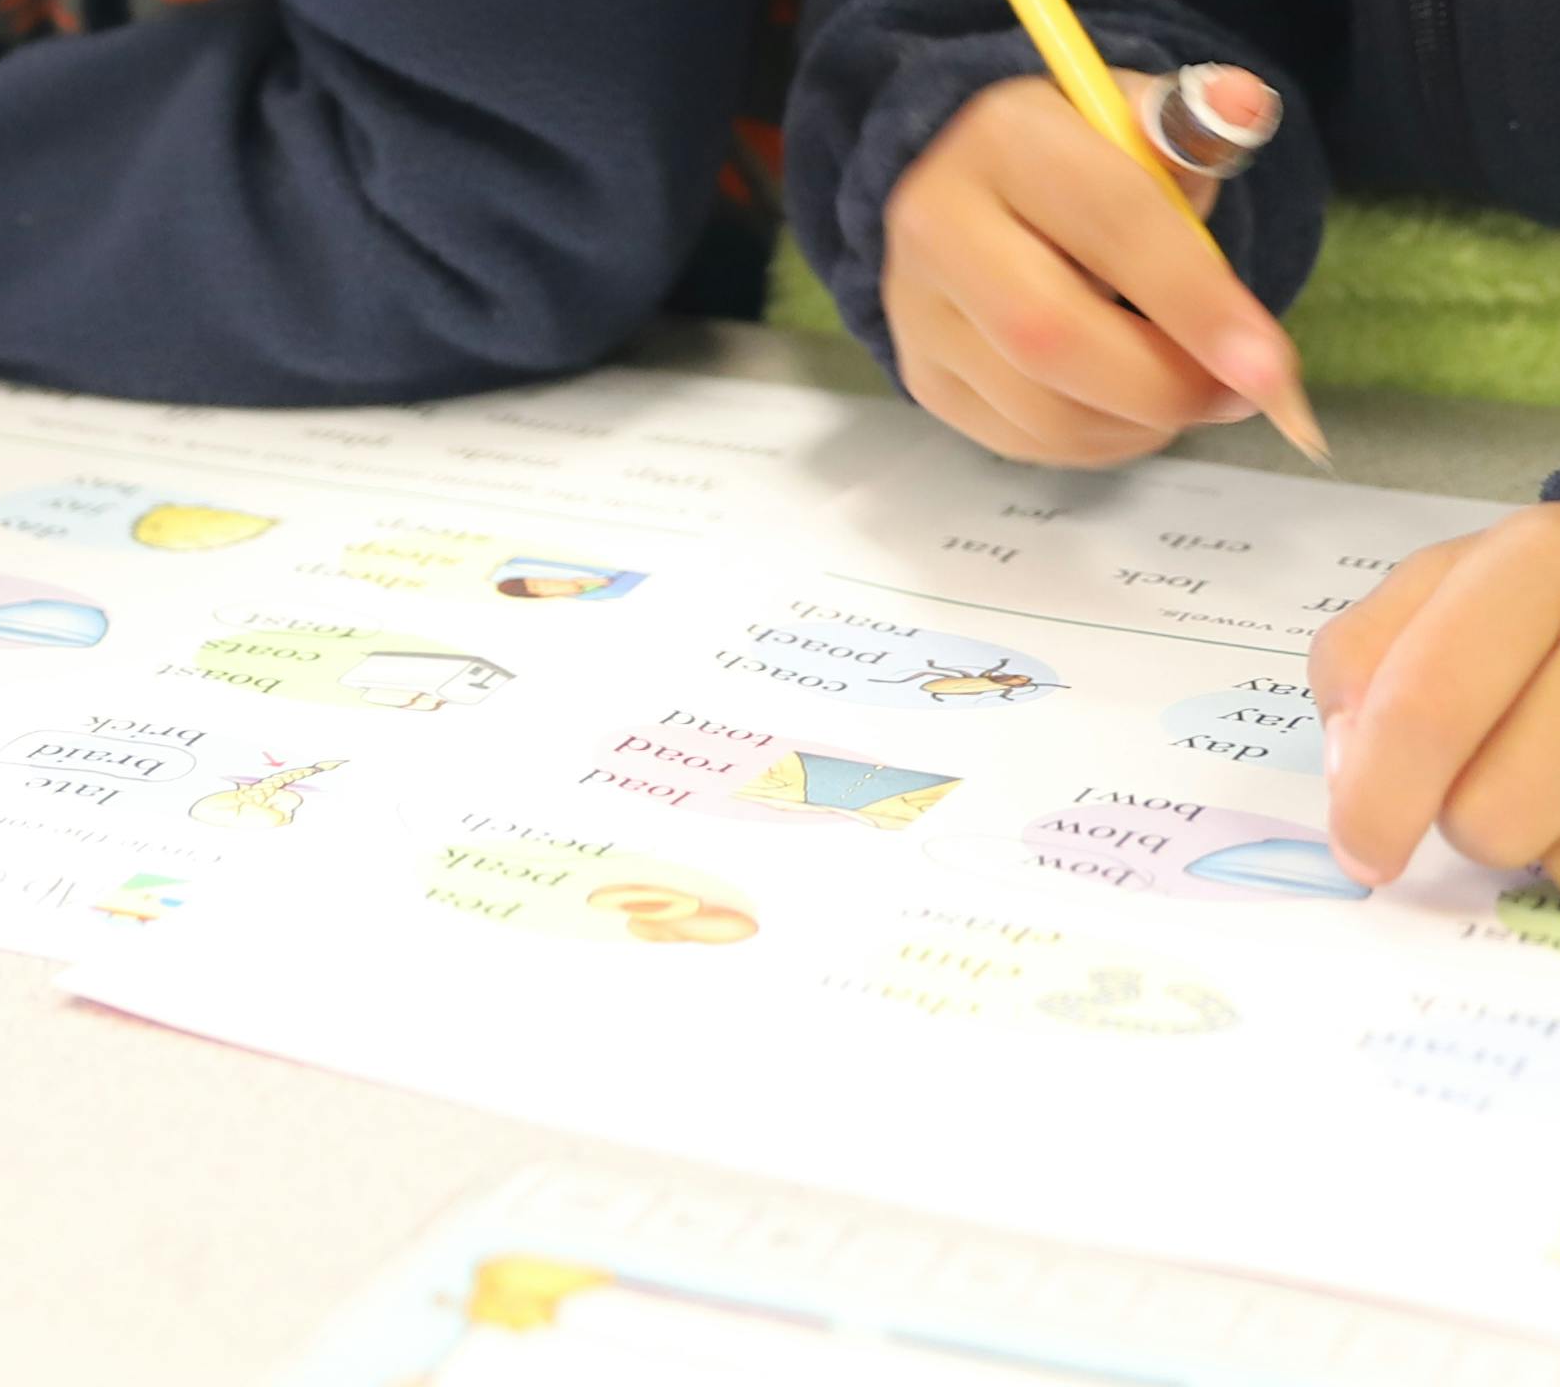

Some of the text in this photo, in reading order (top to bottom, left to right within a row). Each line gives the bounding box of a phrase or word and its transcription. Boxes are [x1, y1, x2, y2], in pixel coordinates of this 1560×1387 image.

[938, 534, 1022, 563] hat
[1155, 528, 1255, 555] crib
[1109, 565, 1209, 595] lock
[787, 596, 919, 638] roach
[1154, 604, 1273, 634] vowels.
[198, 638, 321, 663] coats
[743, 622, 888, 666] poach
[153, 662, 283, 694] boast
[711, 648, 848, 692] coach
[87, 714, 208, 747] brick
[656, 706, 774, 747] toad
[1214, 706, 1315, 734] jay
[34, 741, 177, 777] braid
[611, 731, 739, 774] road
[1166, 733, 1269, 762] day
[21, 775, 127, 807] late
[576, 766, 696, 806] load
[1071, 784, 1208, 822] bowl
[458, 809, 616, 857] peach
[1041, 816, 1172, 855] blow
[435, 844, 575, 887] peak
[1019, 852, 1136, 887] bow
[422, 886, 522, 919] pea
